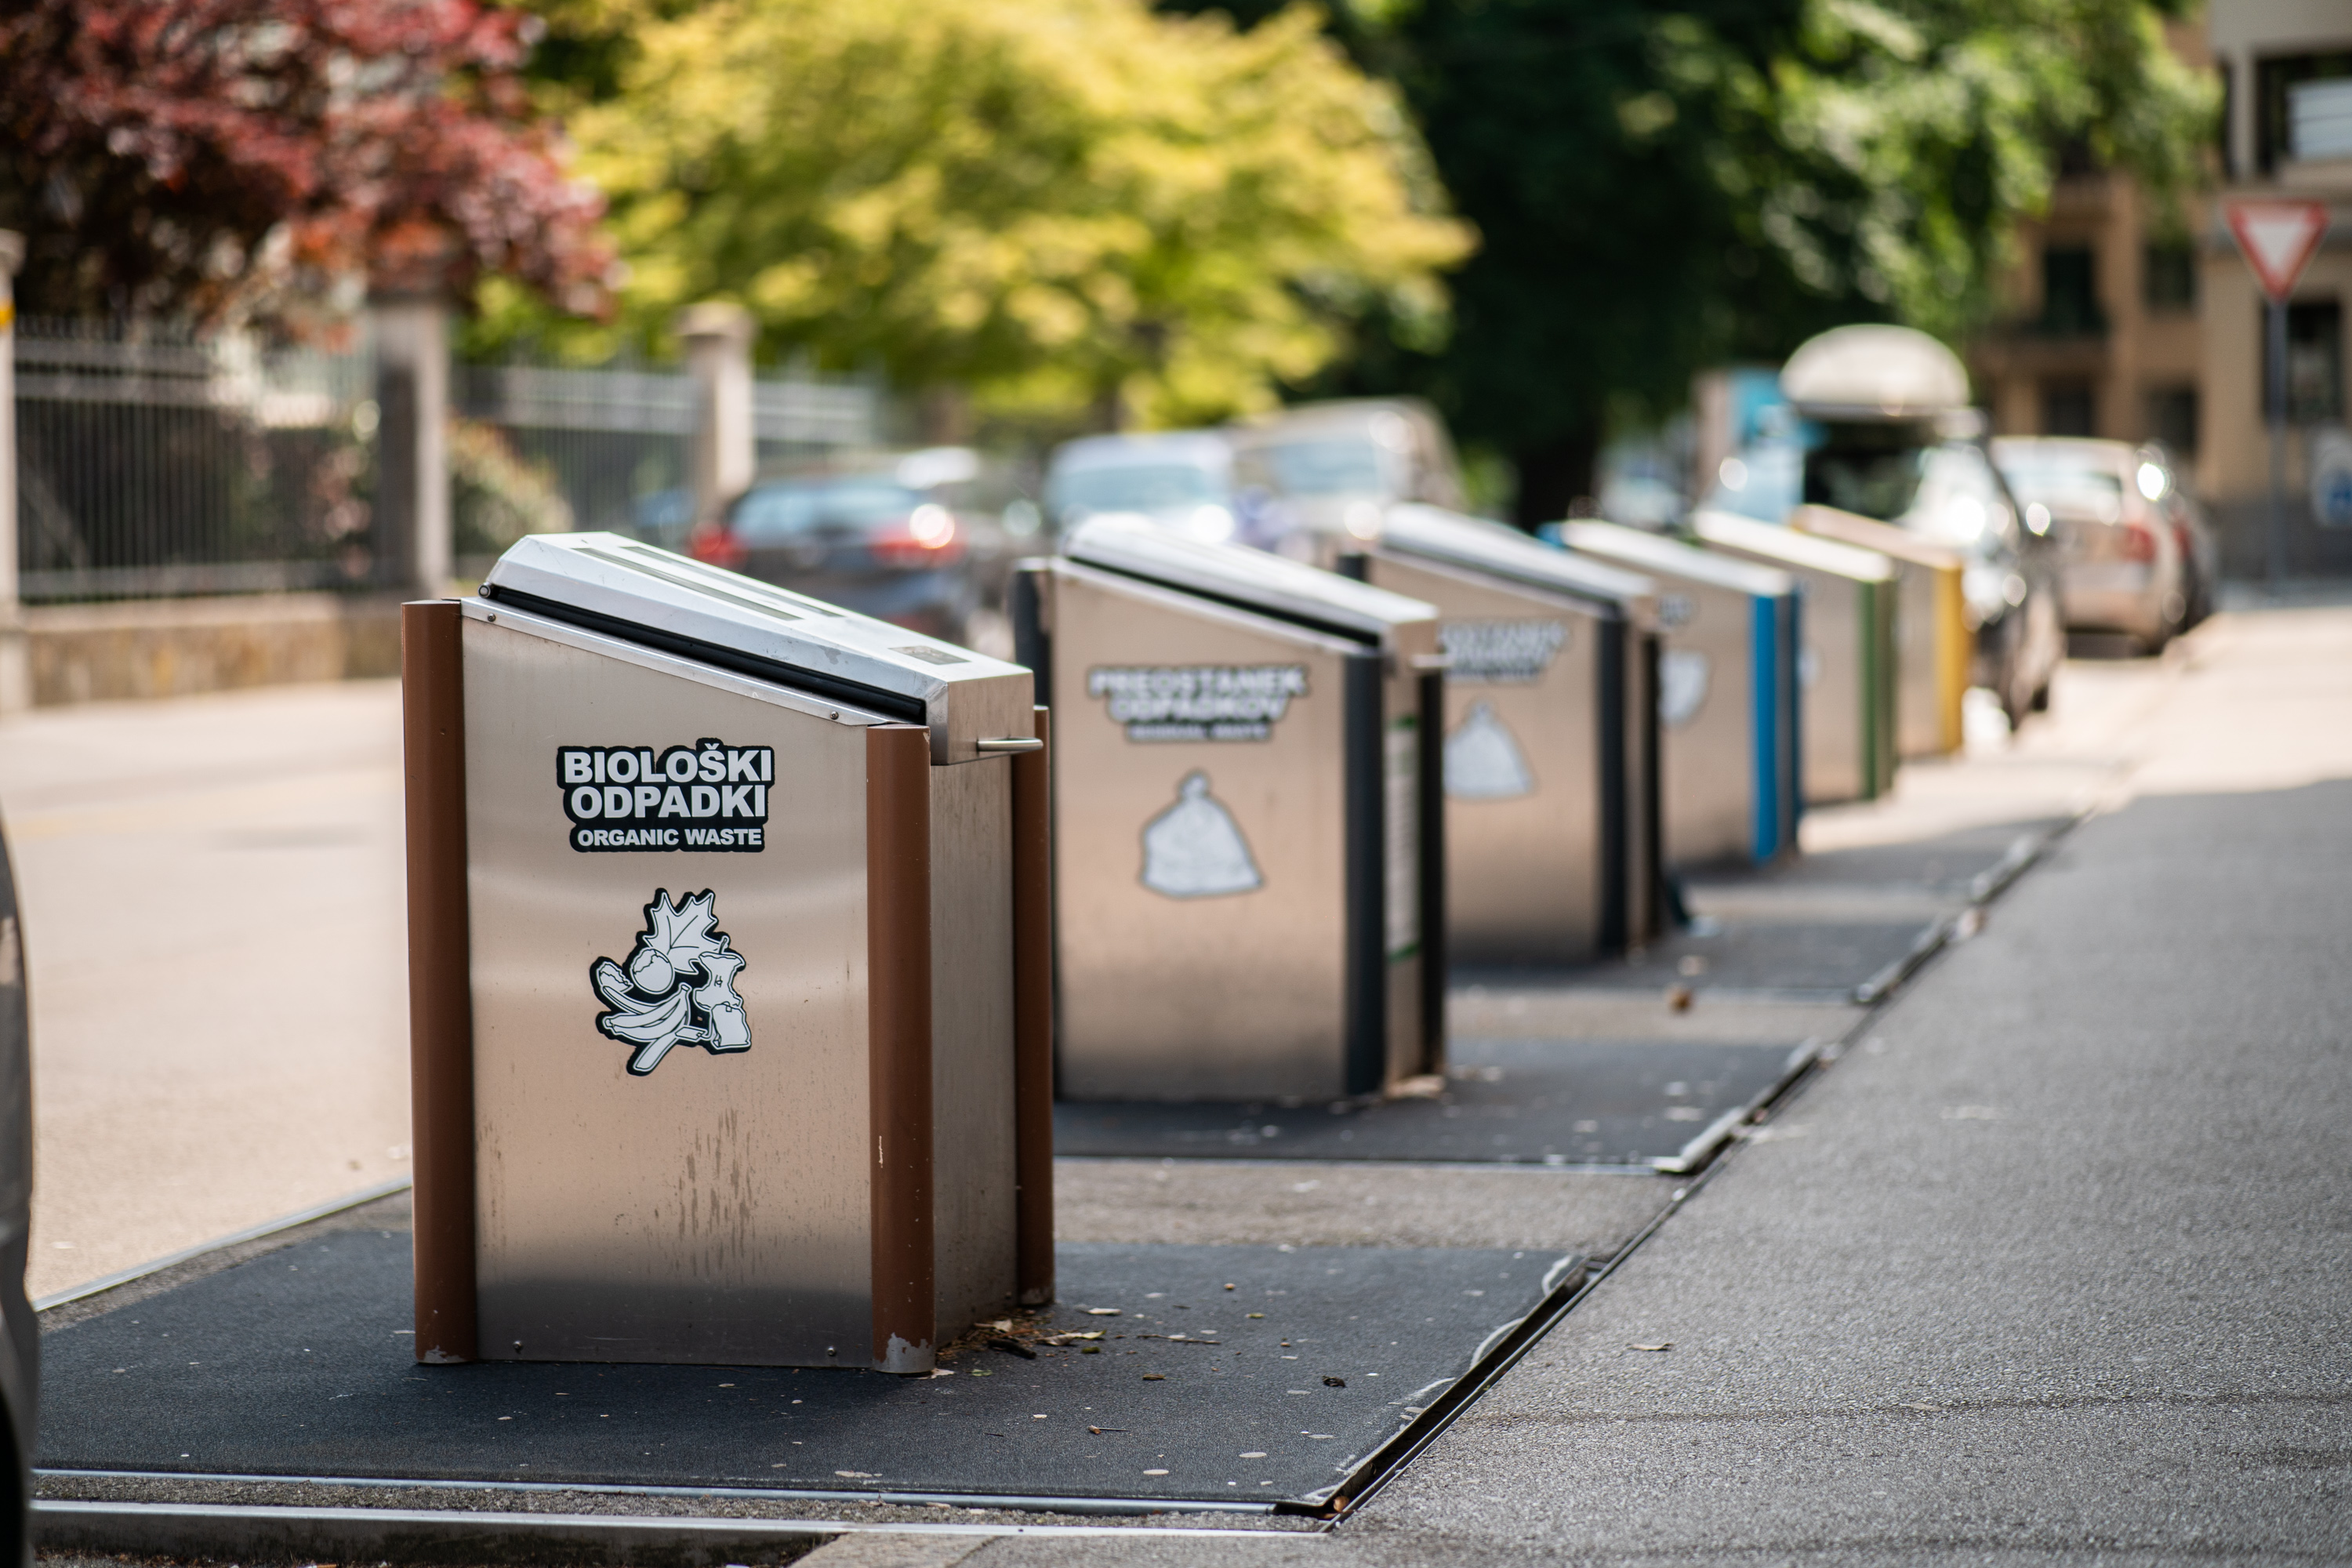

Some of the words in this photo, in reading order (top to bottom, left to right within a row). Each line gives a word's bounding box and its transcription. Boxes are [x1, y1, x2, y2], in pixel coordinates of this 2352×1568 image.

[564, 742, 771, 783] BIOLOŠKI
[571, 785, 765, 818] ODPADKI
[577, 829, 680, 847] ORGANIC
[684, 828, 762, 845] WASTE
